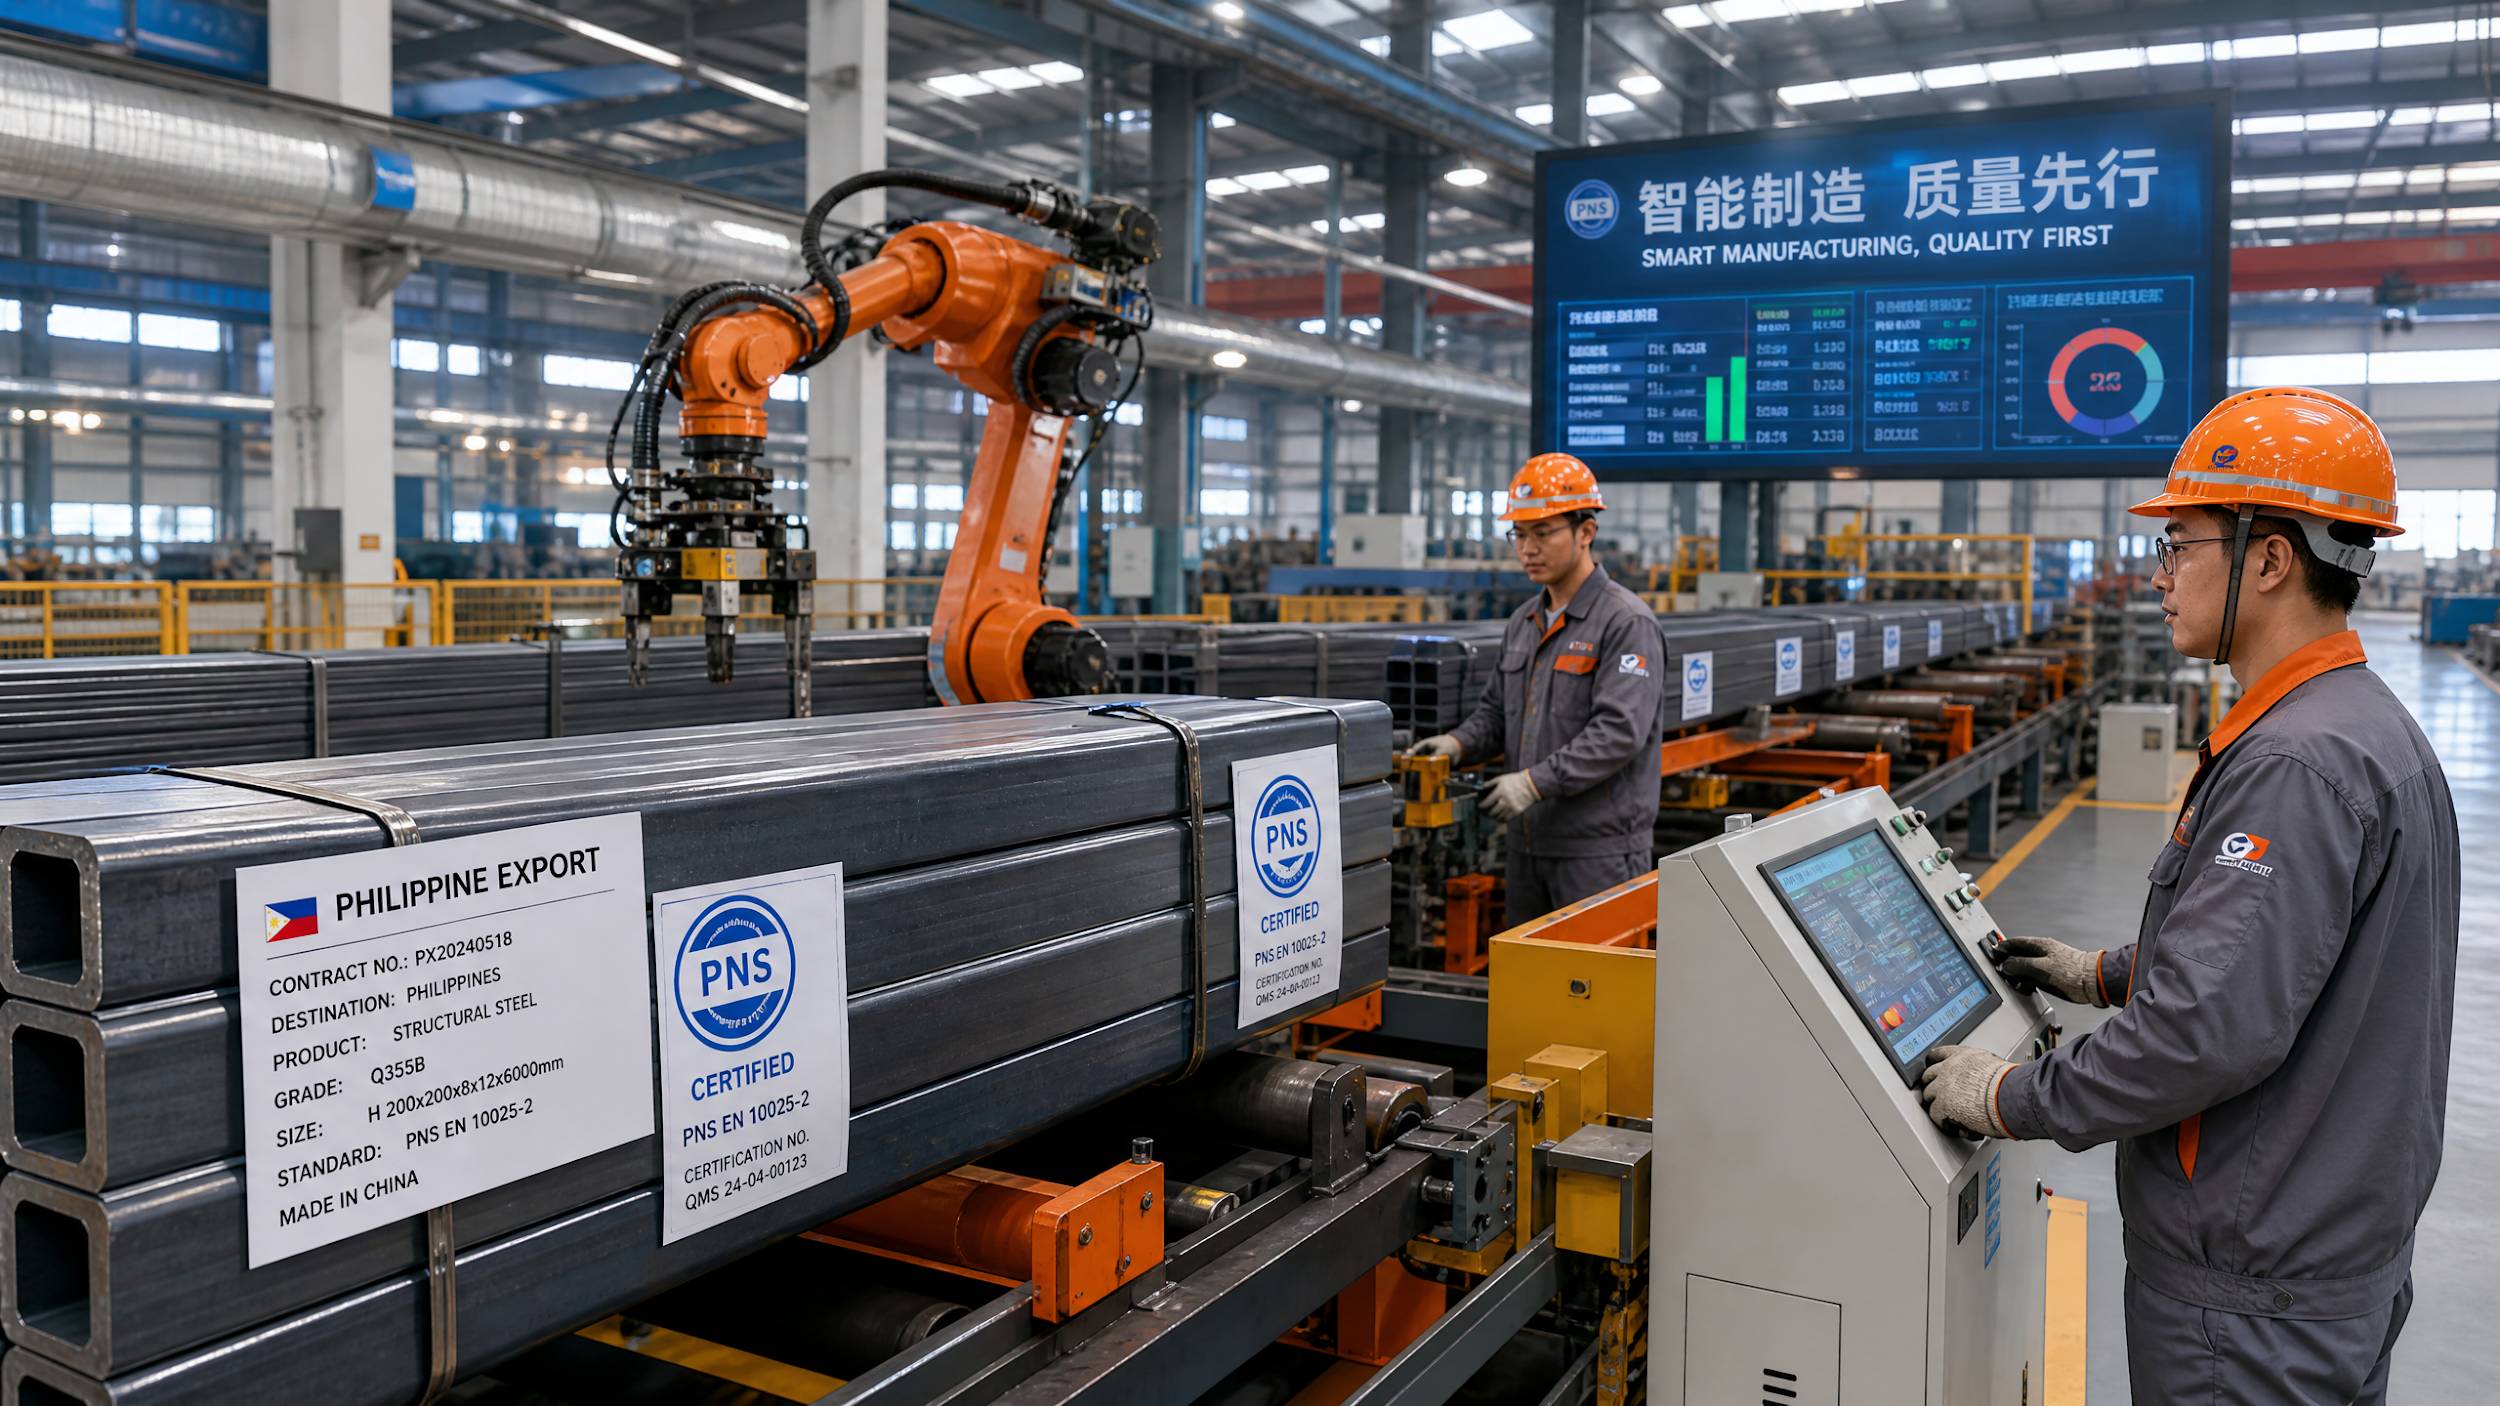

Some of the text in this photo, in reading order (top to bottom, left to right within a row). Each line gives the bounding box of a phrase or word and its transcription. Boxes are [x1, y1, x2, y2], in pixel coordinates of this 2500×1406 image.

[1576, 201, 1607, 217] PNS
[1638, 147, 2159, 235] 智能制造 质量先行
[1641, 224, 2113, 268] SMART MANUFACTURING, QUALITY FIRST
[1267, 818, 1308, 854] PNS
[335, 846, 601, 921] PHILIPPINE EXPORT
[1261, 900, 1320, 934] CERTIFIED
[269, 931, 513, 997] CONTRACT NO.: PX20240518
[701, 947, 773, 998] PNS
[1255, 931, 1326, 968] PNS EN 10025-2
[271, 967, 502, 1034] DESTINATION: PHILIPPINES
[273, 992, 537, 1072] PRODUCT: STRUCTURAL STEEL
[274, 1056, 425, 1109] GRADE: Q355B
[276, 1057, 564, 1148] SIZE: H 200x200x8x12x6000mm
[691, 1051, 795, 1101] CERTIFIED
[277, 1098, 534, 1187] STANDARD: PNS EN 10025-2
[683, 1089, 810, 1148] PNS EN 10025-2
[684, 1129, 810, 1184] CERTIFICATION NO.
[685, 1153, 808, 1211] QMS 24-04-00123
[279, 1169, 419, 1227] MADE IN CHINA
